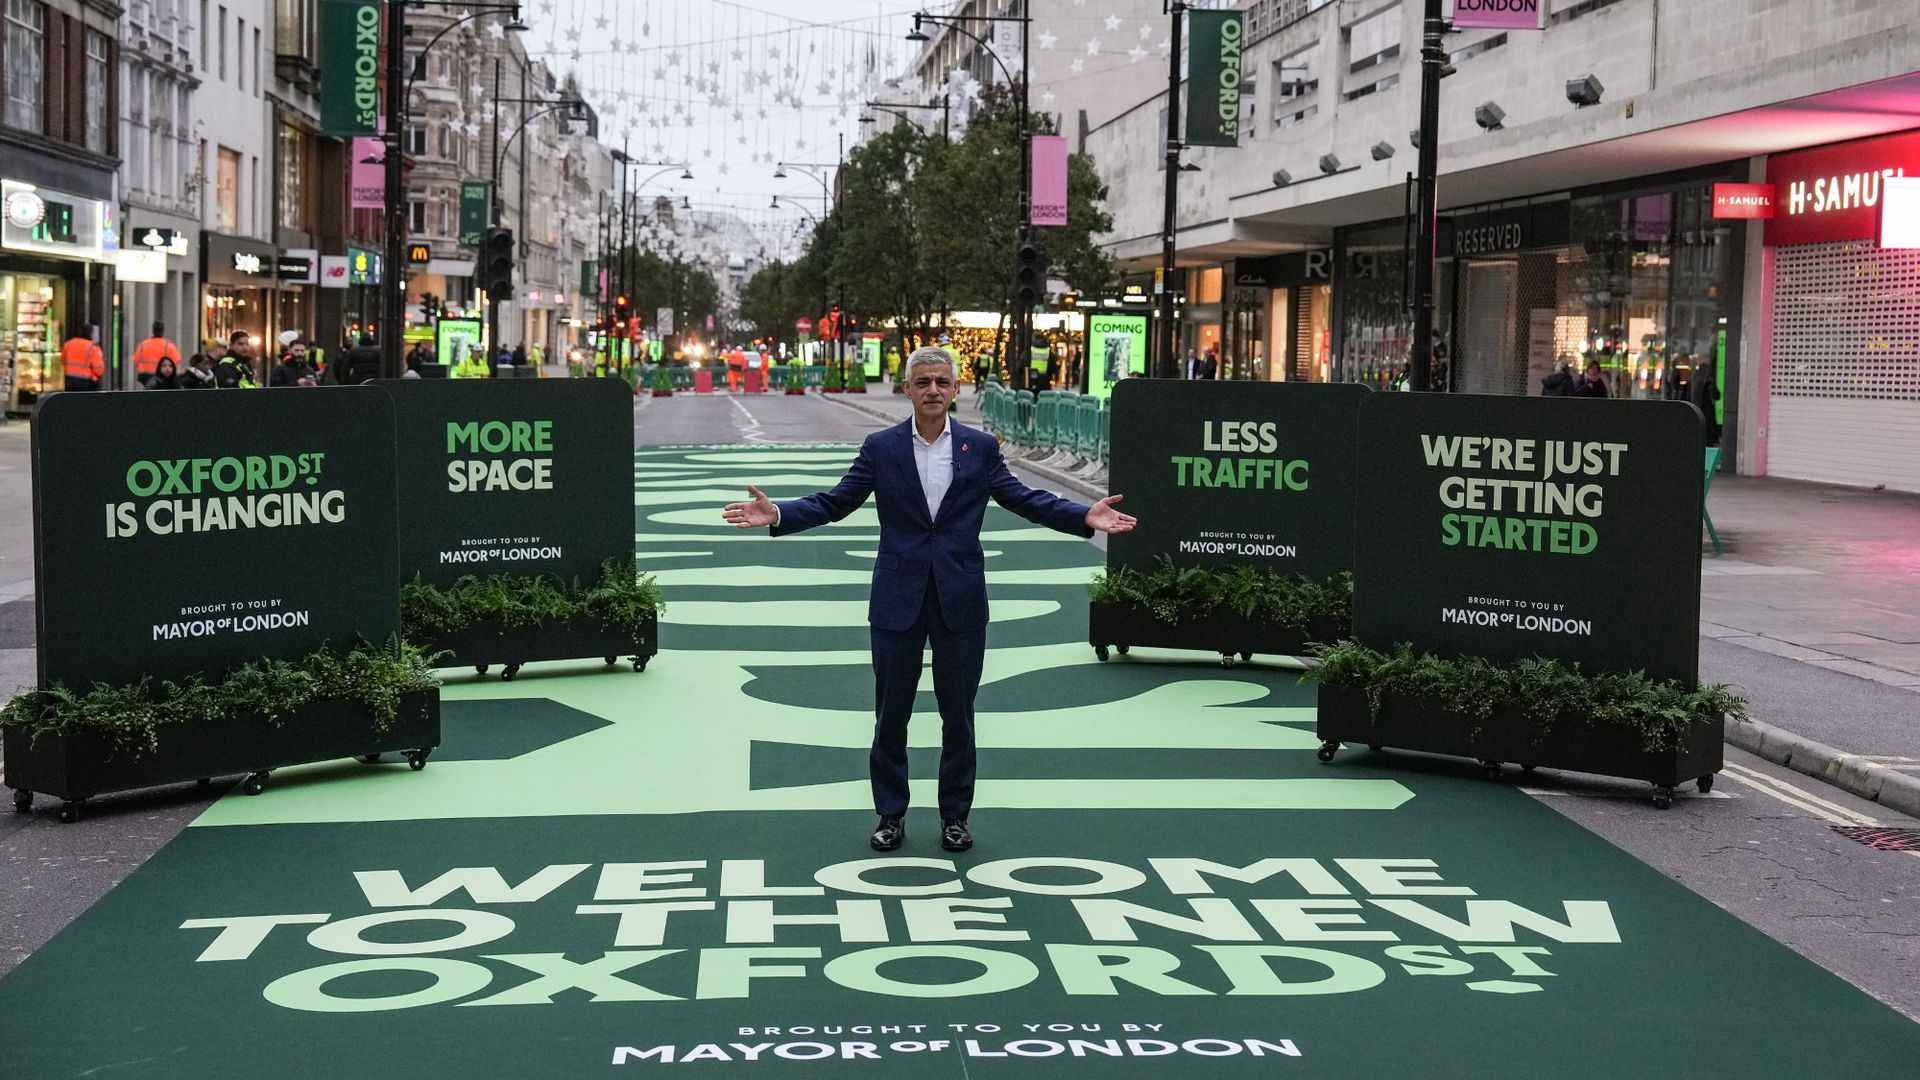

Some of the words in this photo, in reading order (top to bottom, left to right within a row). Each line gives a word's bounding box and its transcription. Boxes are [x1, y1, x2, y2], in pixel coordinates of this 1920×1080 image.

[1457, 0, 1537, 12] LONDON
[355, 5, 378, 109] OXFORD
[1219, 19, 1241, 120] OXFORD
[1456, 223, 1521, 254] RESERVED
[1093, 322, 1143, 334] COMING
[447, 421, 553, 453] MORE
[1204, 421, 1277, 453] LESS
[126, 455, 297, 497] OXFORD
[448, 459, 553, 492] SPACE
[1172, 456, 1308, 490] TRAFFIC
[1543, 440, 1628, 481] JUST
[1439, 476, 1603, 518] GETTING
[106, 502, 138, 538] IS
[145, 489, 345, 535] CHANGING
[461, 537, 498, 546] BROUGHT
[499, 537, 511, 545] TO
[1180, 541, 1224, 553] MAYOR
[1238, 544, 1295, 557] LONDON
[1199, 531, 1234, 539] BROUGHT
[1236, 532, 1247, 540] TO
[1441, 513, 1599, 555] STARTED
[440, 550, 488, 563] MAYOR
[489, 549, 501, 557] OF
[502, 547, 561, 560] LONDON
[181, 603, 227, 616] BROUGHT
[230, 602, 244, 611] TO
[247, 599, 267, 609] YOU
[270, 598, 282, 607] BY
[1468, 596, 1511, 607] BROUGHT
[1514, 600, 1527, 609] TO
[1530, 601, 1550, 611] YOU
[1553, 603, 1565, 612] BY
[153, 620, 215, 640] MAYOR
[217, 618, 231, 628] OF
[234, 607, 308, 632] LONDON
[1443, 608, 1498, 626] MAYOR
[1500, 613, 1514, 622] OF
[1517, 615, 1591, 635] LONDON
[353, 857, 1478, 907] WELCOME
[179, 909, 515, 962] TO
[575, 897, 1031, 946] THE
[1071, 899, 1622, 943] NEW
[263, 945, 1387, 1012] OXFORD
[739, 1025, 926, 1035] BROUGHT
[949, 1024, 1000, 1032] TO
[1023, 1024, 1100, 1032] YOU
[612, 1042, 881, 1064] MAYOR
[890, 1040, 950, 1052] OF
[965, 1039, 1302, 1056] LONDON
